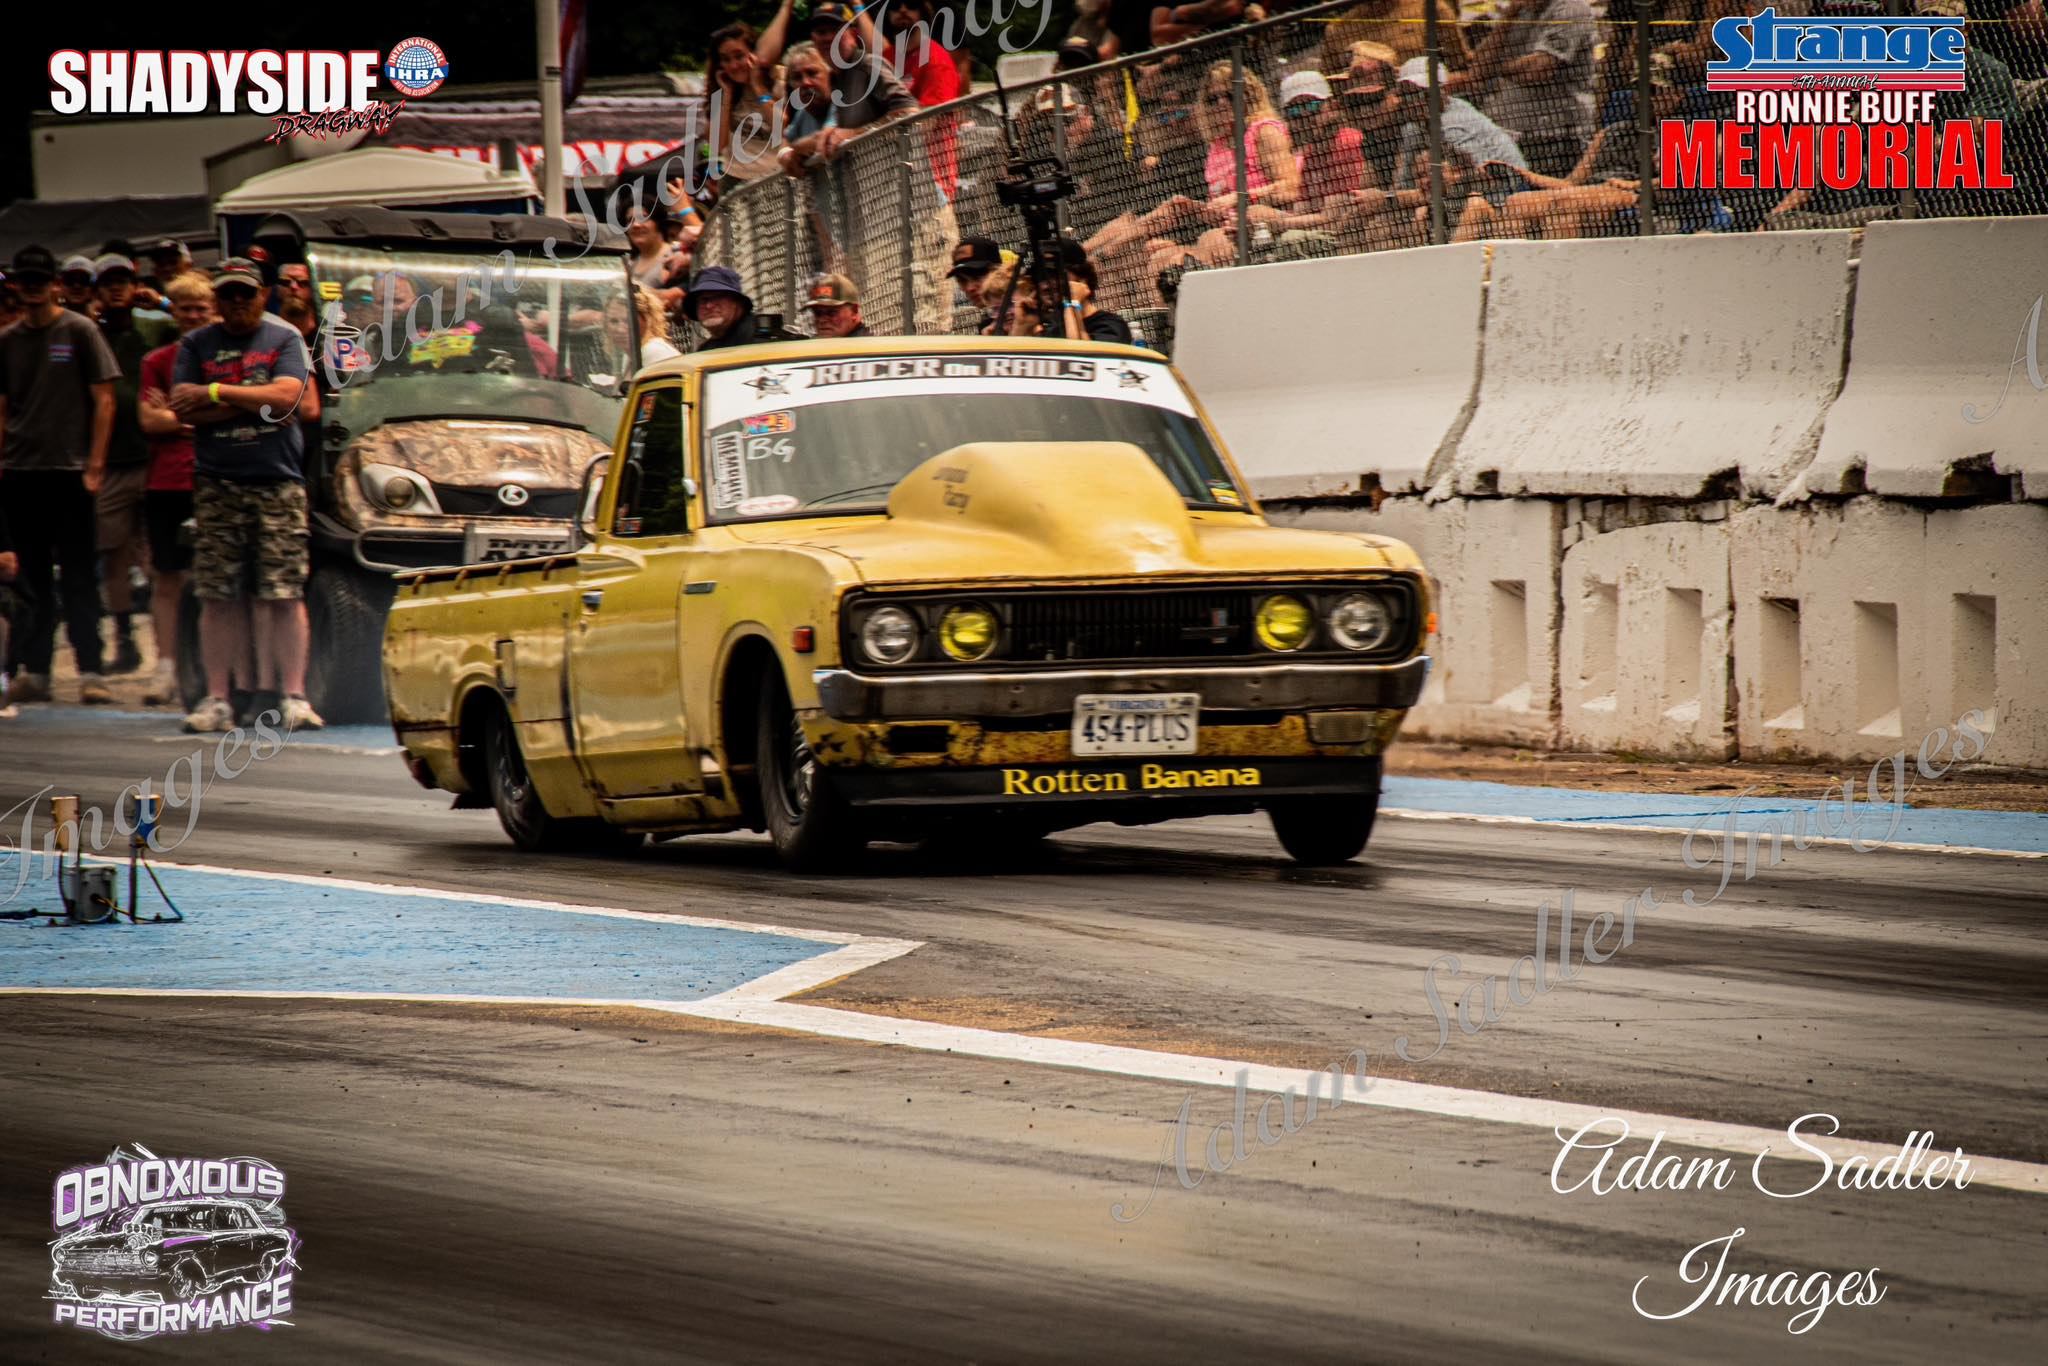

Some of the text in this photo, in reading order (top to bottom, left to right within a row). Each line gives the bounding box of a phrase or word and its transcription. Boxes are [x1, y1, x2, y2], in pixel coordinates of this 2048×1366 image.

[814, 358, 941, 386] RACER
[984, 358, 1095, 381] RAILS
[1081, 713, 1190, 743] 454-PLUS
[1001, 763, 1262, 796] Rotten Banana
